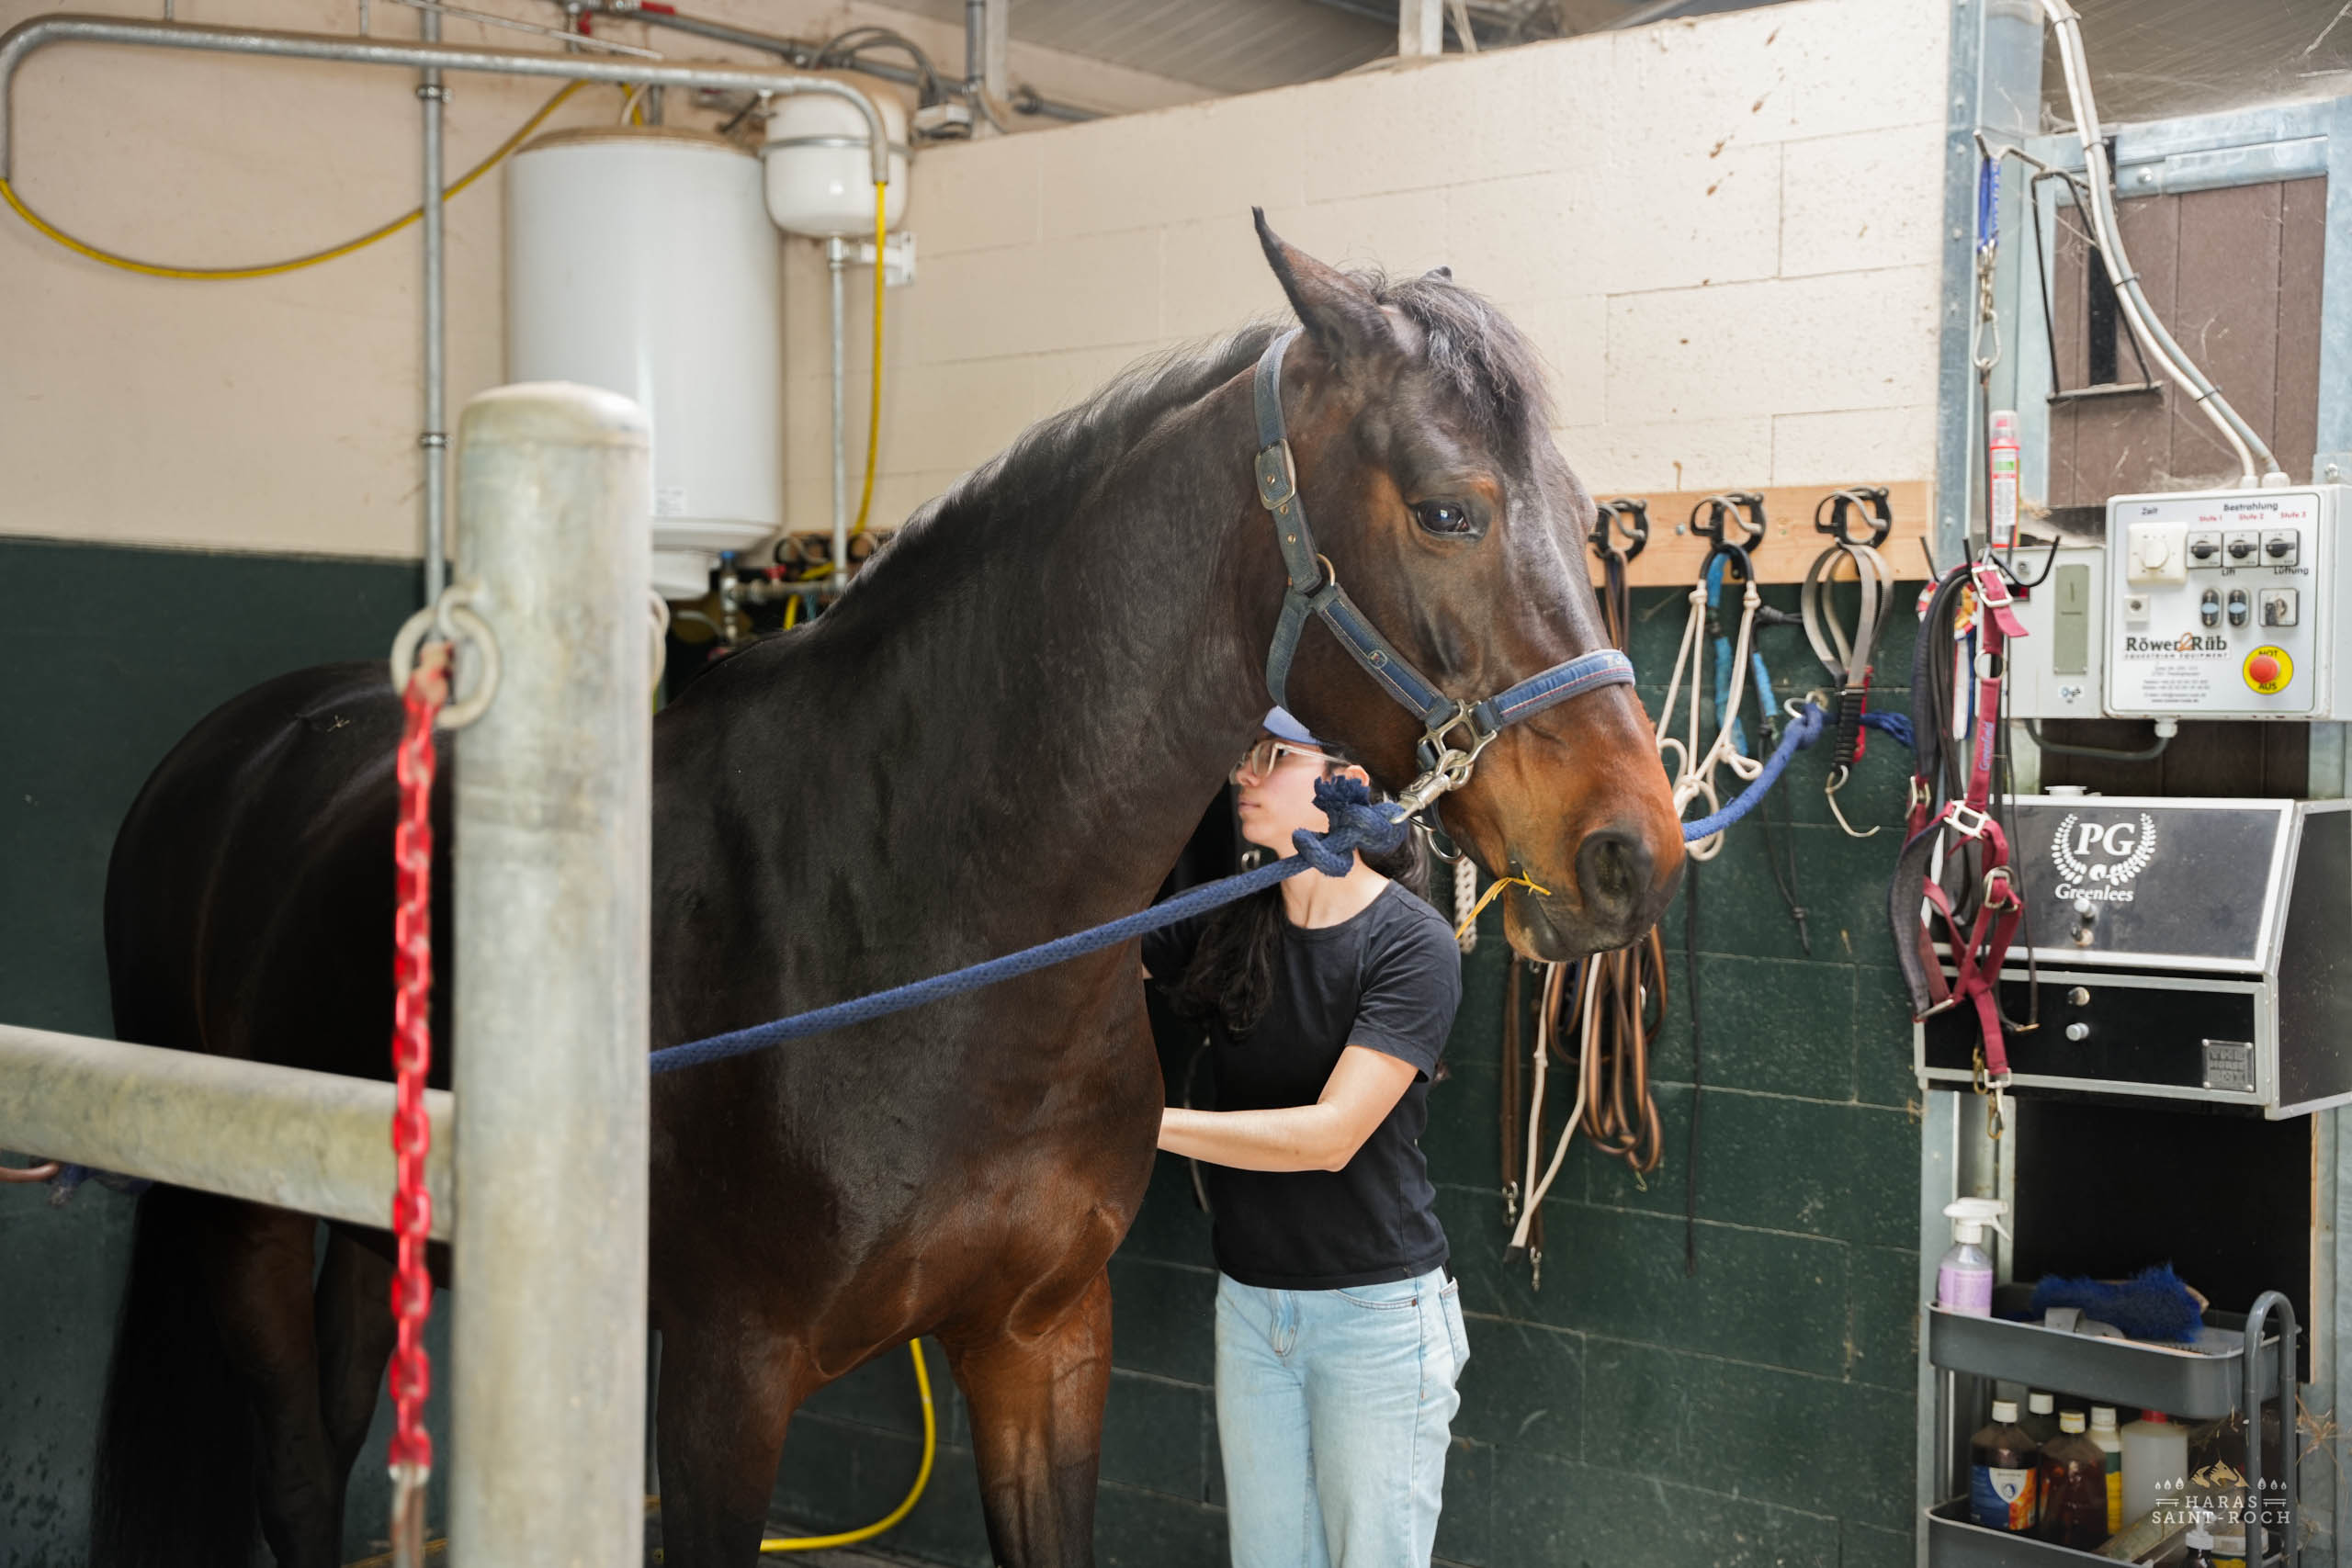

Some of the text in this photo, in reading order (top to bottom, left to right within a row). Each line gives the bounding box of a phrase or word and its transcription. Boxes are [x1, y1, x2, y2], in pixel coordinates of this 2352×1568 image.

[2223, 502, 2278, 512] Bestrahlung
[2258, 682, 2278, 691] AUS
[2074, 823, 2135, 856] PG
[2055, 883, 2134, 901] Greenlees
